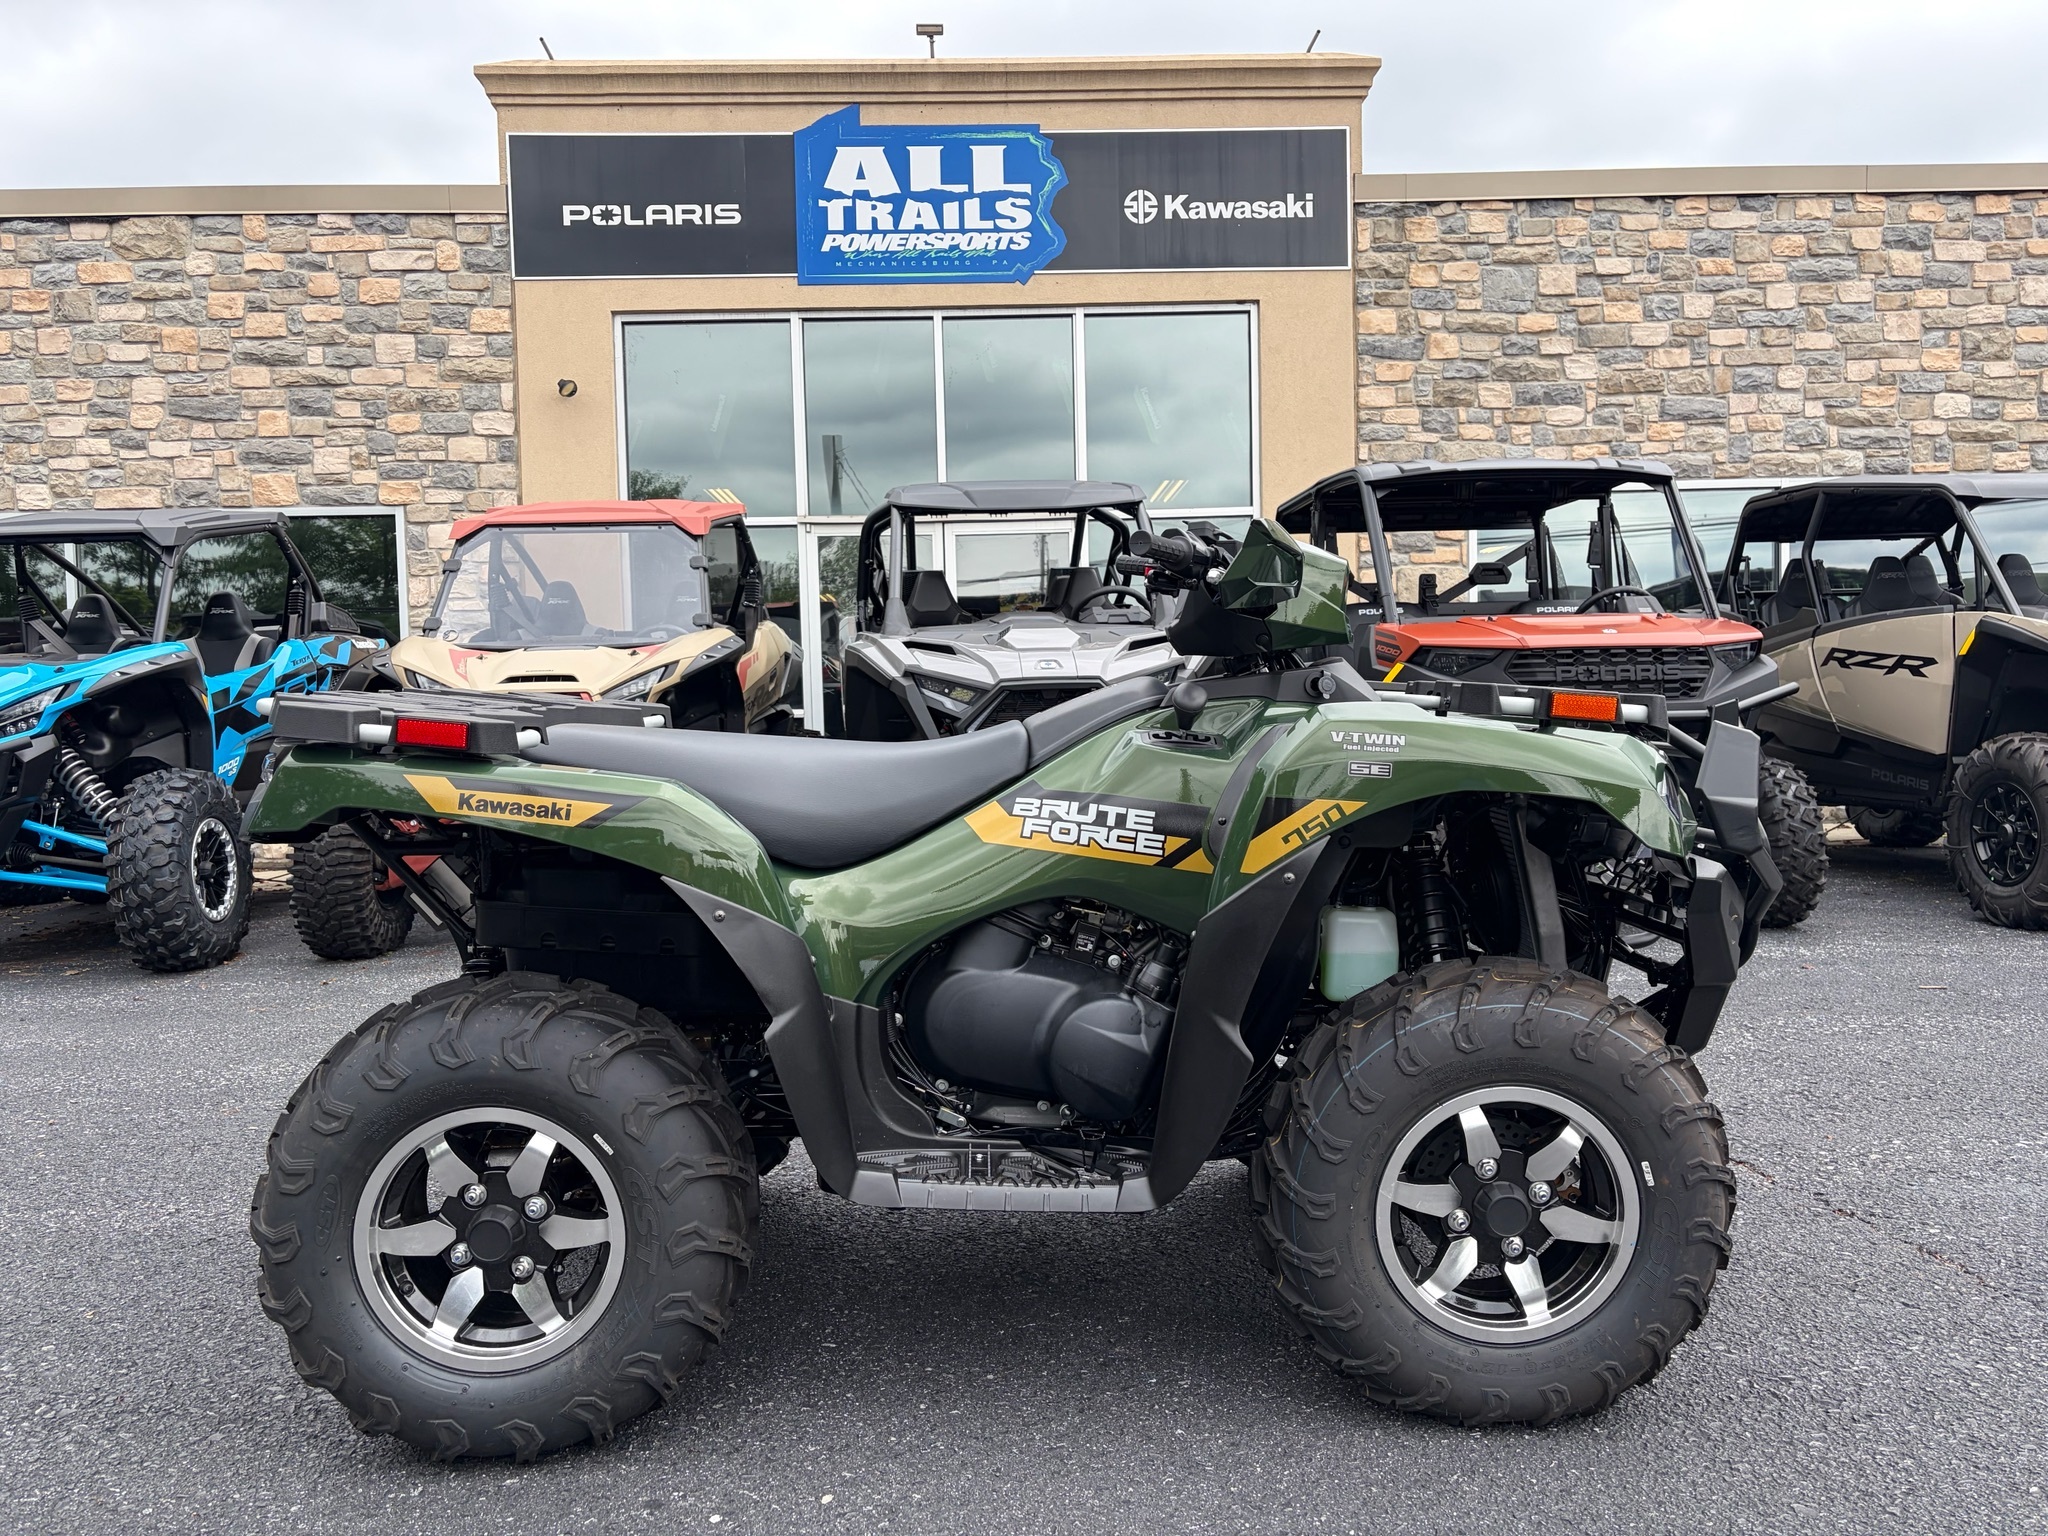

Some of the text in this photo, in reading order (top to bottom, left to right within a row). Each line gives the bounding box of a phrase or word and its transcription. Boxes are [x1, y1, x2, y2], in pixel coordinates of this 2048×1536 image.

[823, 145, 1032, 198] ALL
[562, 203, 742, 226] POLARIS
[819, 197, 1033, 231] TRAILS
[1164, 193, 1314, 220] Kawasaki
[821, 232, 1032, 252] POWERSPORTS
[1358, 607, 1404, 616] POLS
[1376, 644, 1401, 656] 1000
[1555, 663, 1681, 682] POLARIS
[1820, 647, 1939, 678] RZR
[1330, 731, 1406, 746] V-TWIN
[1343, 743, 1361, 751] Fuel
[217, 756, 240, 775] 1000
[1350, 763, 1390, 776] SE
[1871, 768, 1929, 790] POLARIS
[457, 793, 573, 821] Kawasaki
[1012, 797, 1156, 832] BRUTE
[1281, 803, 1347, 845] 750
[1021, 817, 1166, 857] FORCE
